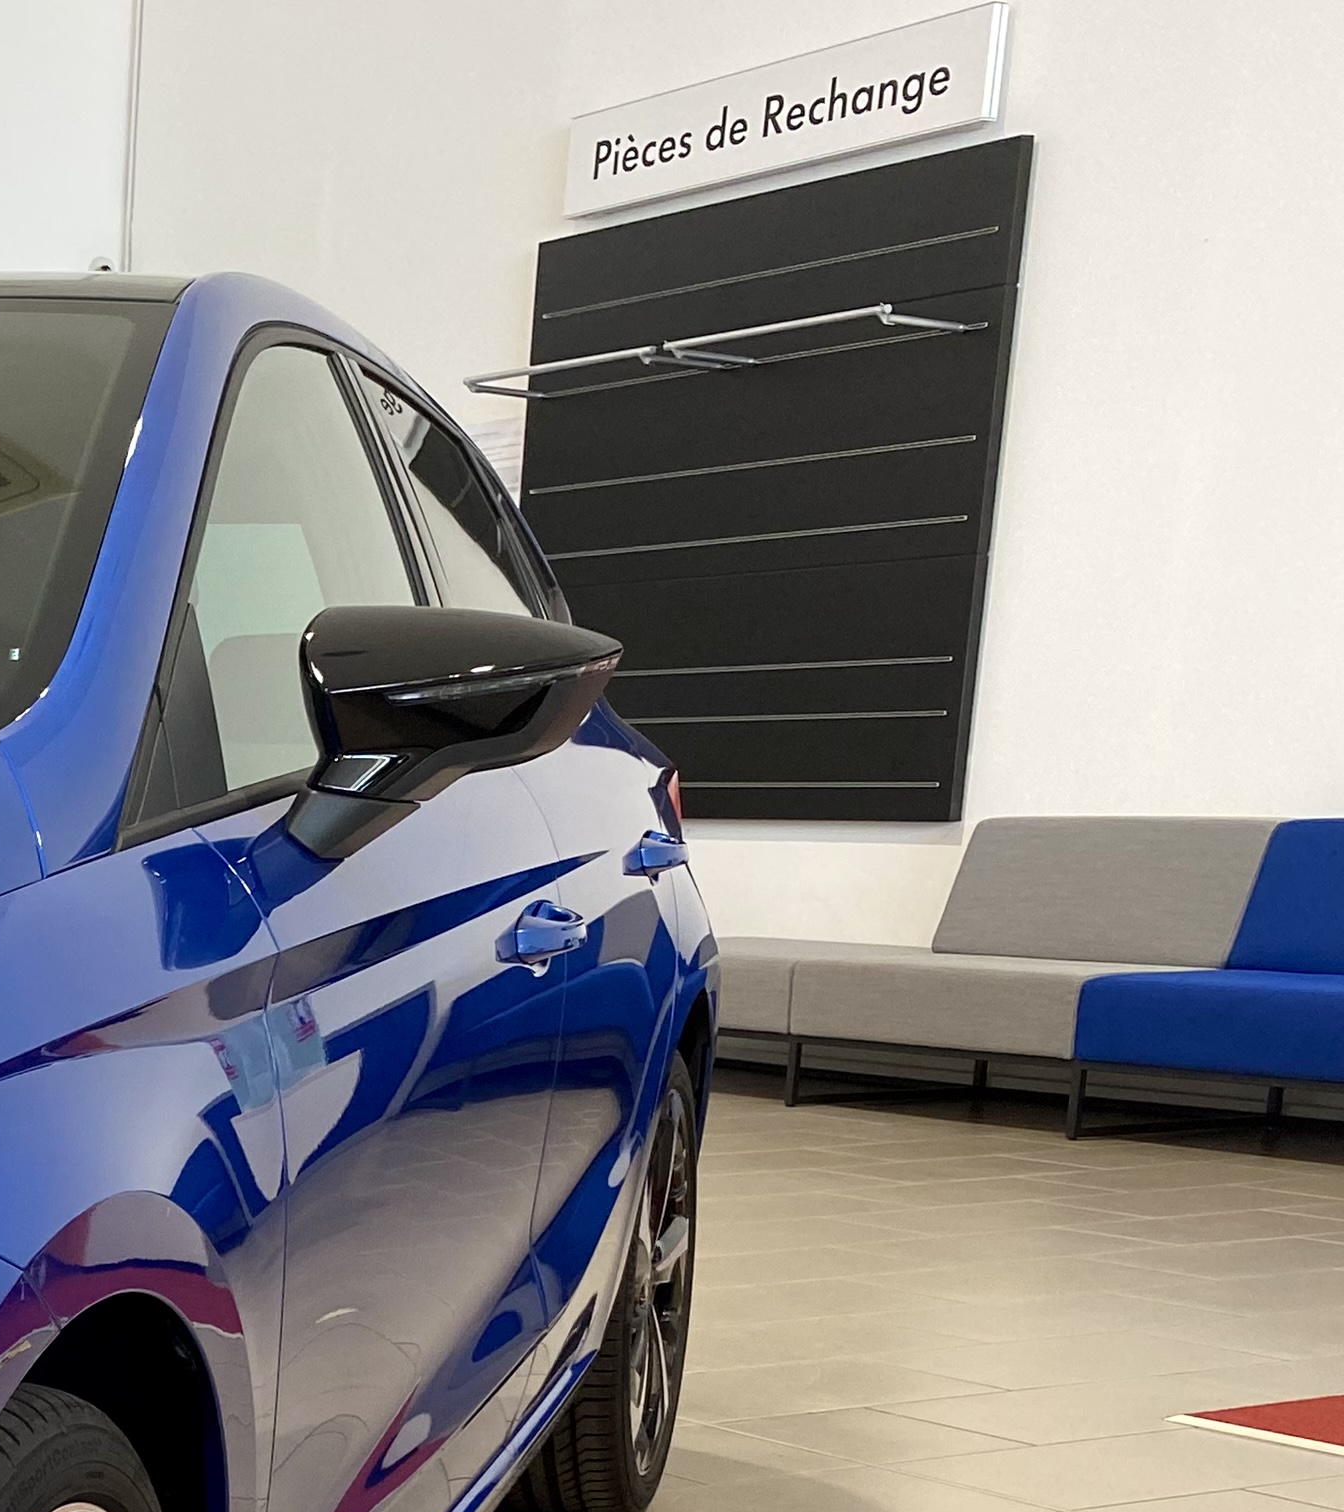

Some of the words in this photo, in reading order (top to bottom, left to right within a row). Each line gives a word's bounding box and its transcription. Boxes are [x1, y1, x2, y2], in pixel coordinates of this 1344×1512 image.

[593, 132, 692, 180] Pièces
[706, 106, 748, 152] de
[762, 66, 951, 138] Rechange
